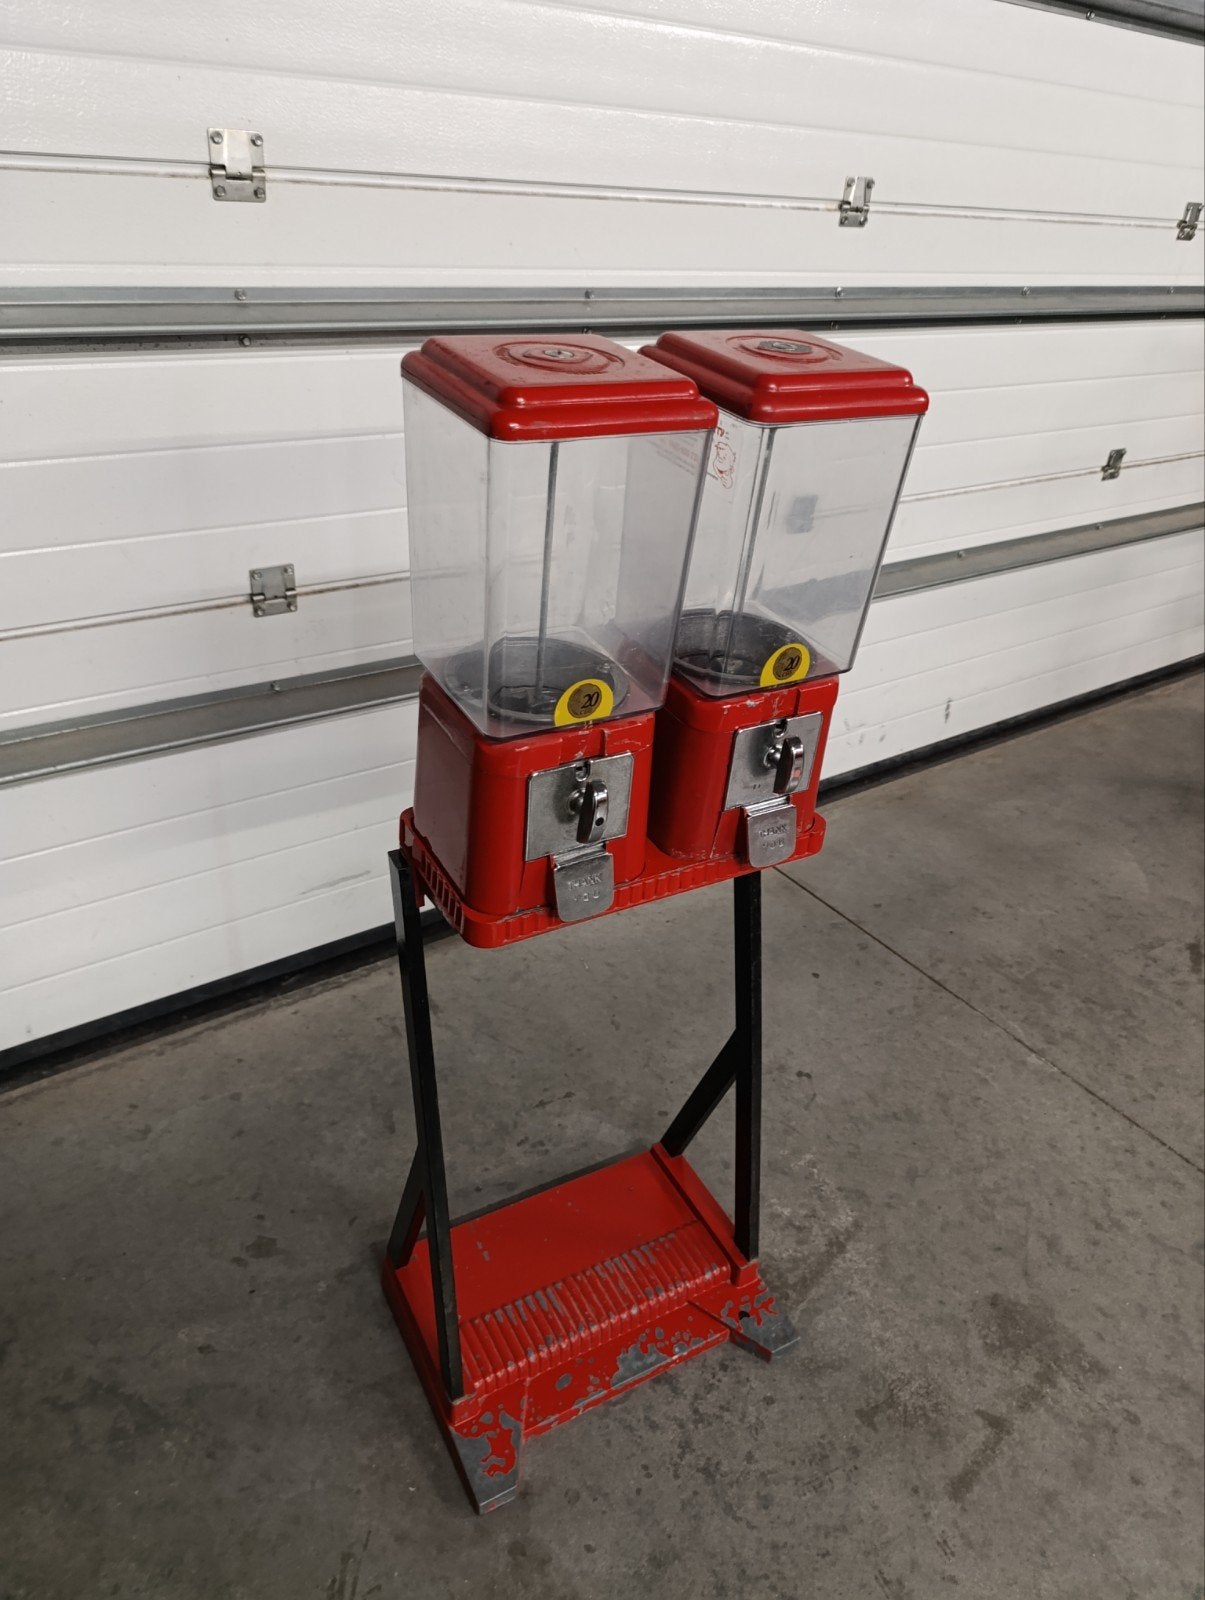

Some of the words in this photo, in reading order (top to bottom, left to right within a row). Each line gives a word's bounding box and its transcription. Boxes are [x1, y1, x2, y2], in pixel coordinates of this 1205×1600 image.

[783, 655, 801, 671] 20
[581, 691, 600, 709] 20
[567, 872, 603, 891] THANK
